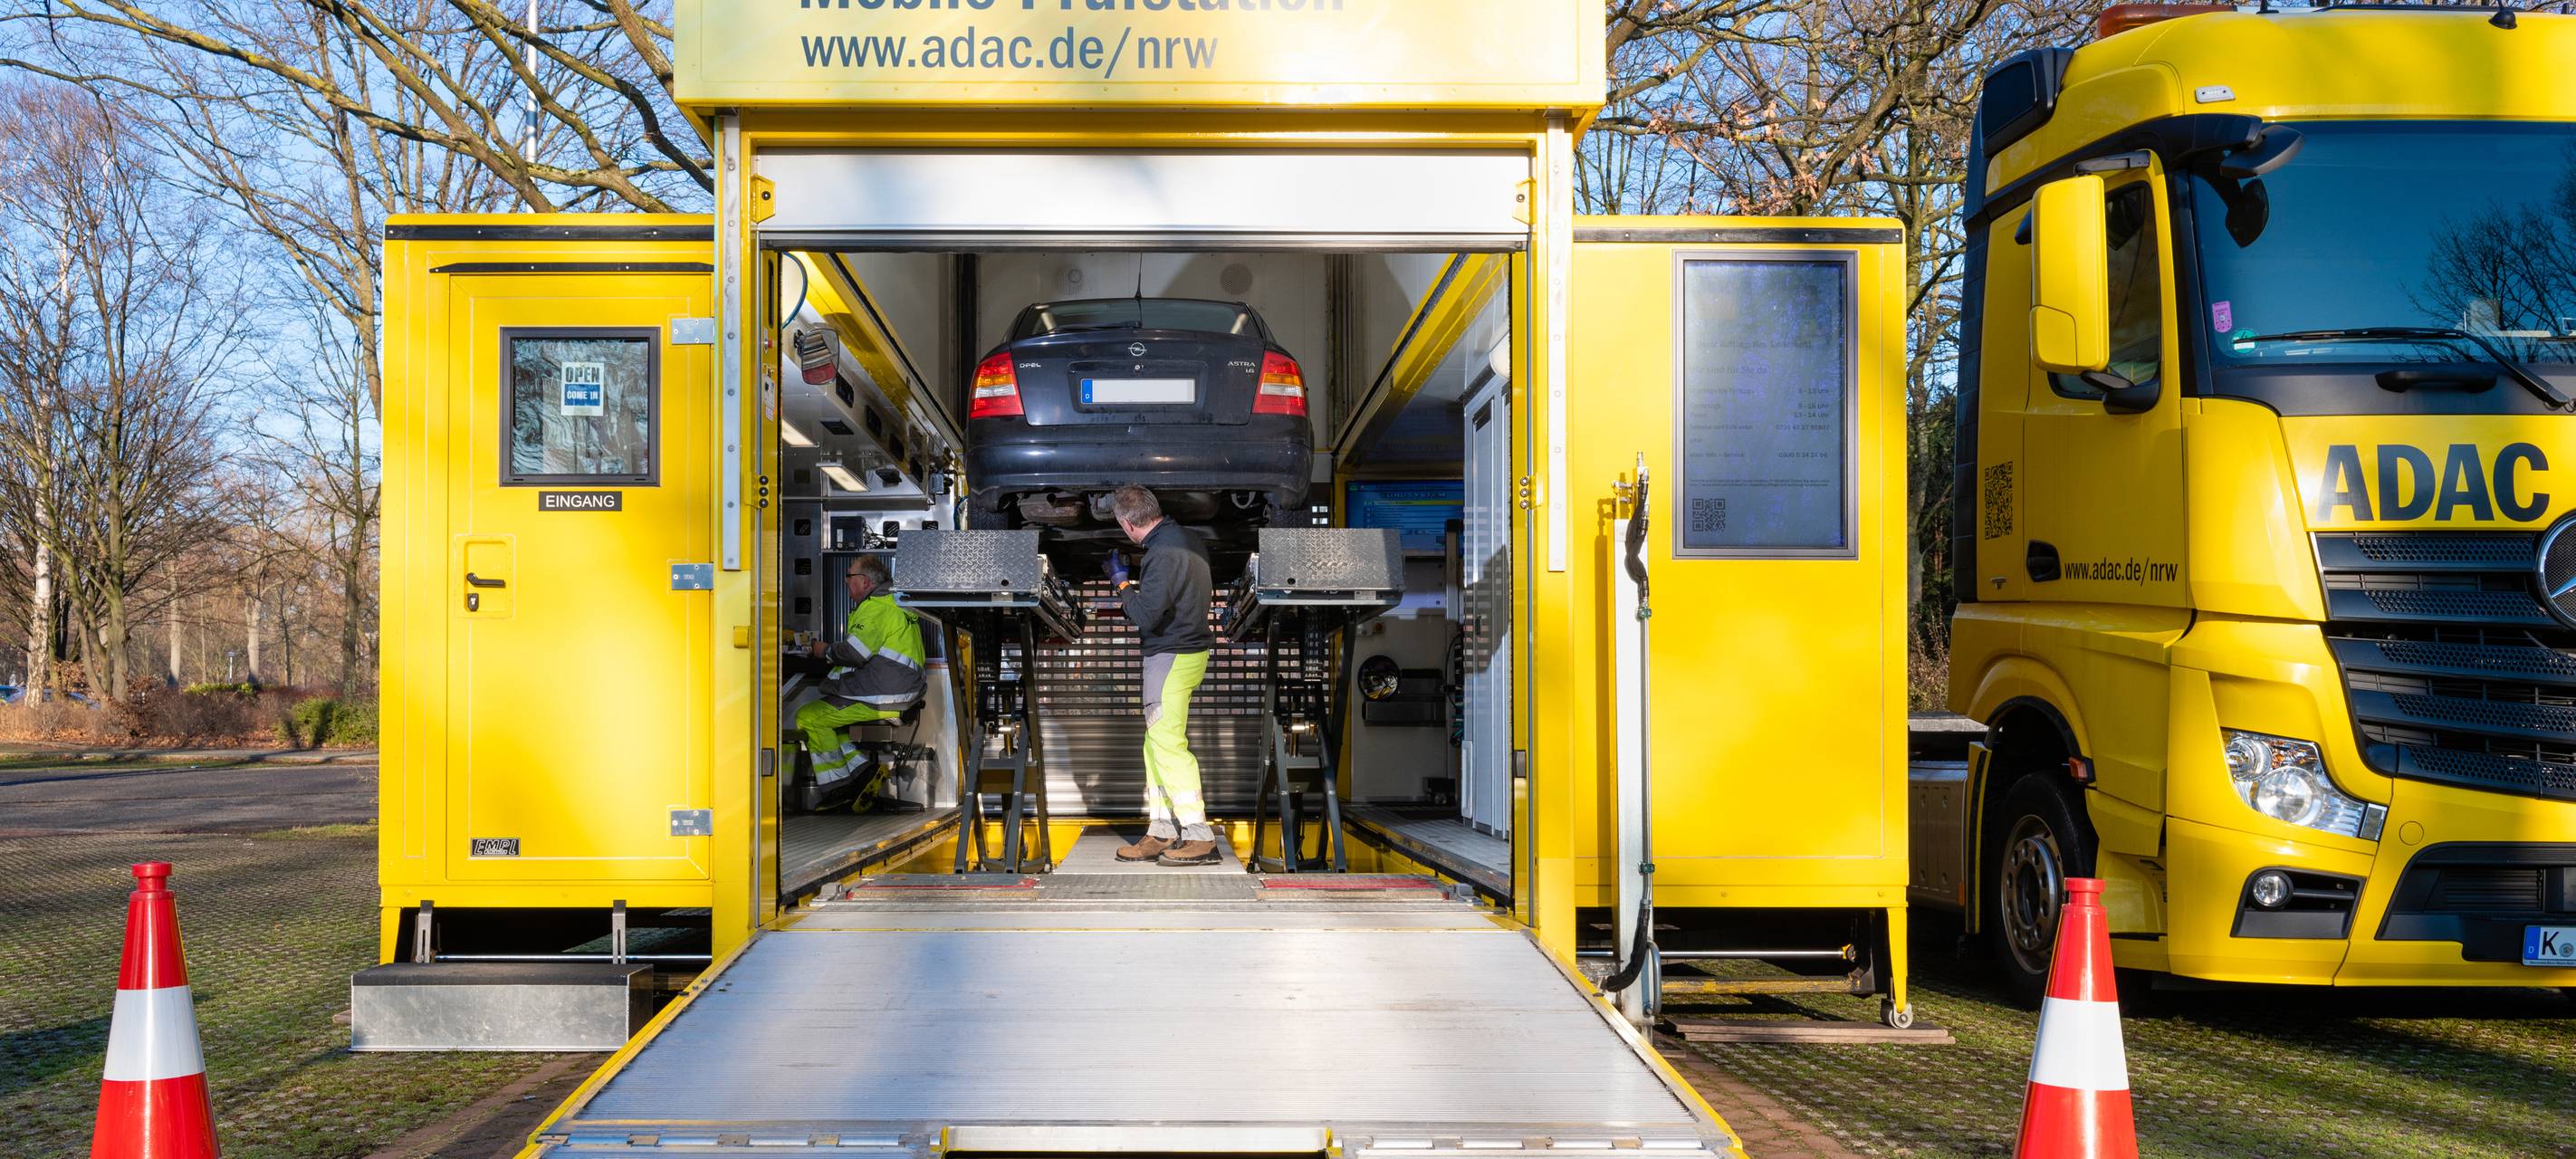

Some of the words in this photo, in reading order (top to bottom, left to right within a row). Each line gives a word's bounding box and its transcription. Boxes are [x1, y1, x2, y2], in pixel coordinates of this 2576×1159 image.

[801, 26, 1219, 80] www.adac.de/nrw
[565, 367, 600, 383] OPEN
[566, 390, 588, 399] COME
[589, 390, 599, 399] IN
[2315, 442, 2550, 522] ADAC
[545, 494, 615, 508] EINGANG
[2064, 557, 2179, 587] www.adac.de/nrw
[474, 839, 517, 855] EMPL
[2528, 945, 2534, 954] D
[2541, 931, 2560, 956] K
